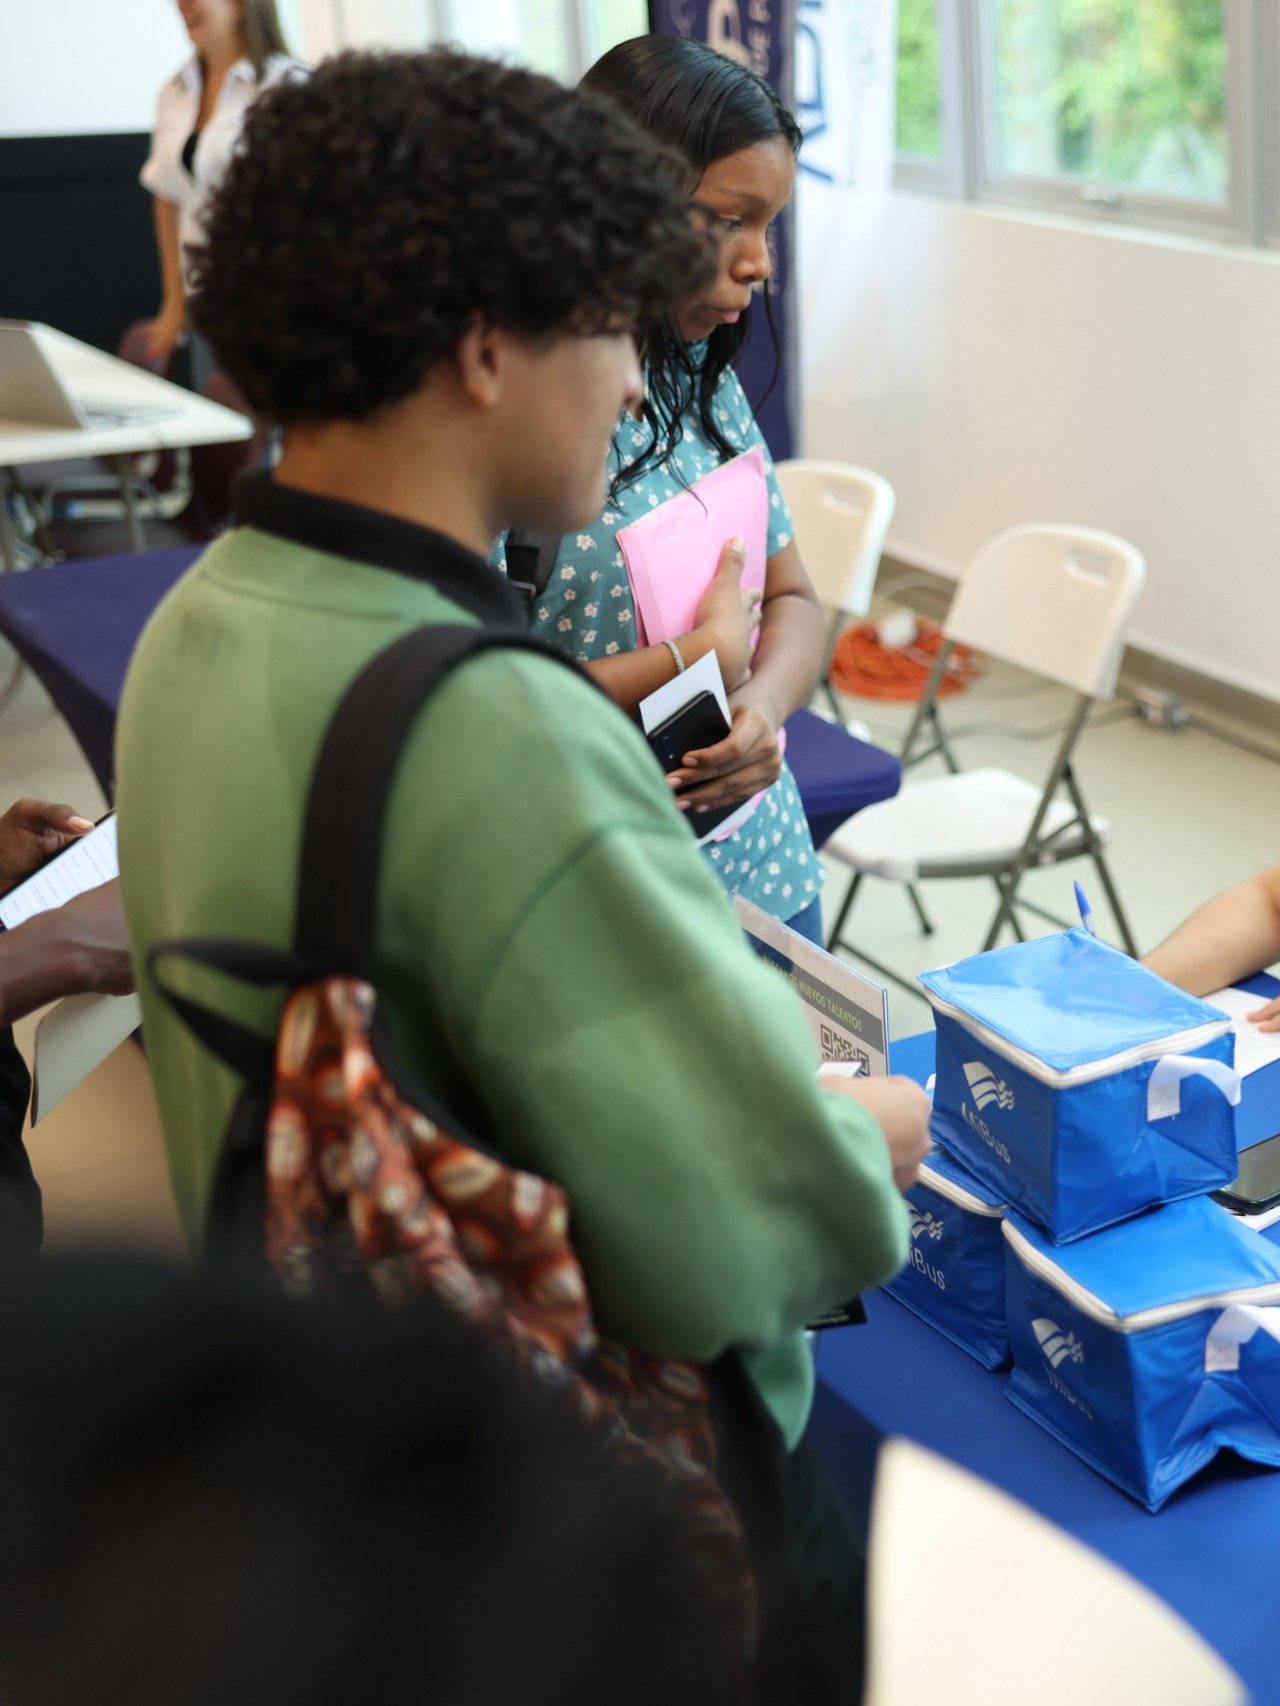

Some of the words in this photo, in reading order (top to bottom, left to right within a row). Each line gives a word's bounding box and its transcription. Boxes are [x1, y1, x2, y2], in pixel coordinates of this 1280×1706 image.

[799, 982, 826, 1007] NUEVOS
[827, 998, 863, 1032] TALENTOS
[961, 1101, 1011, 1164] MiBus
[907, 1242, 946, 1290] iBus
